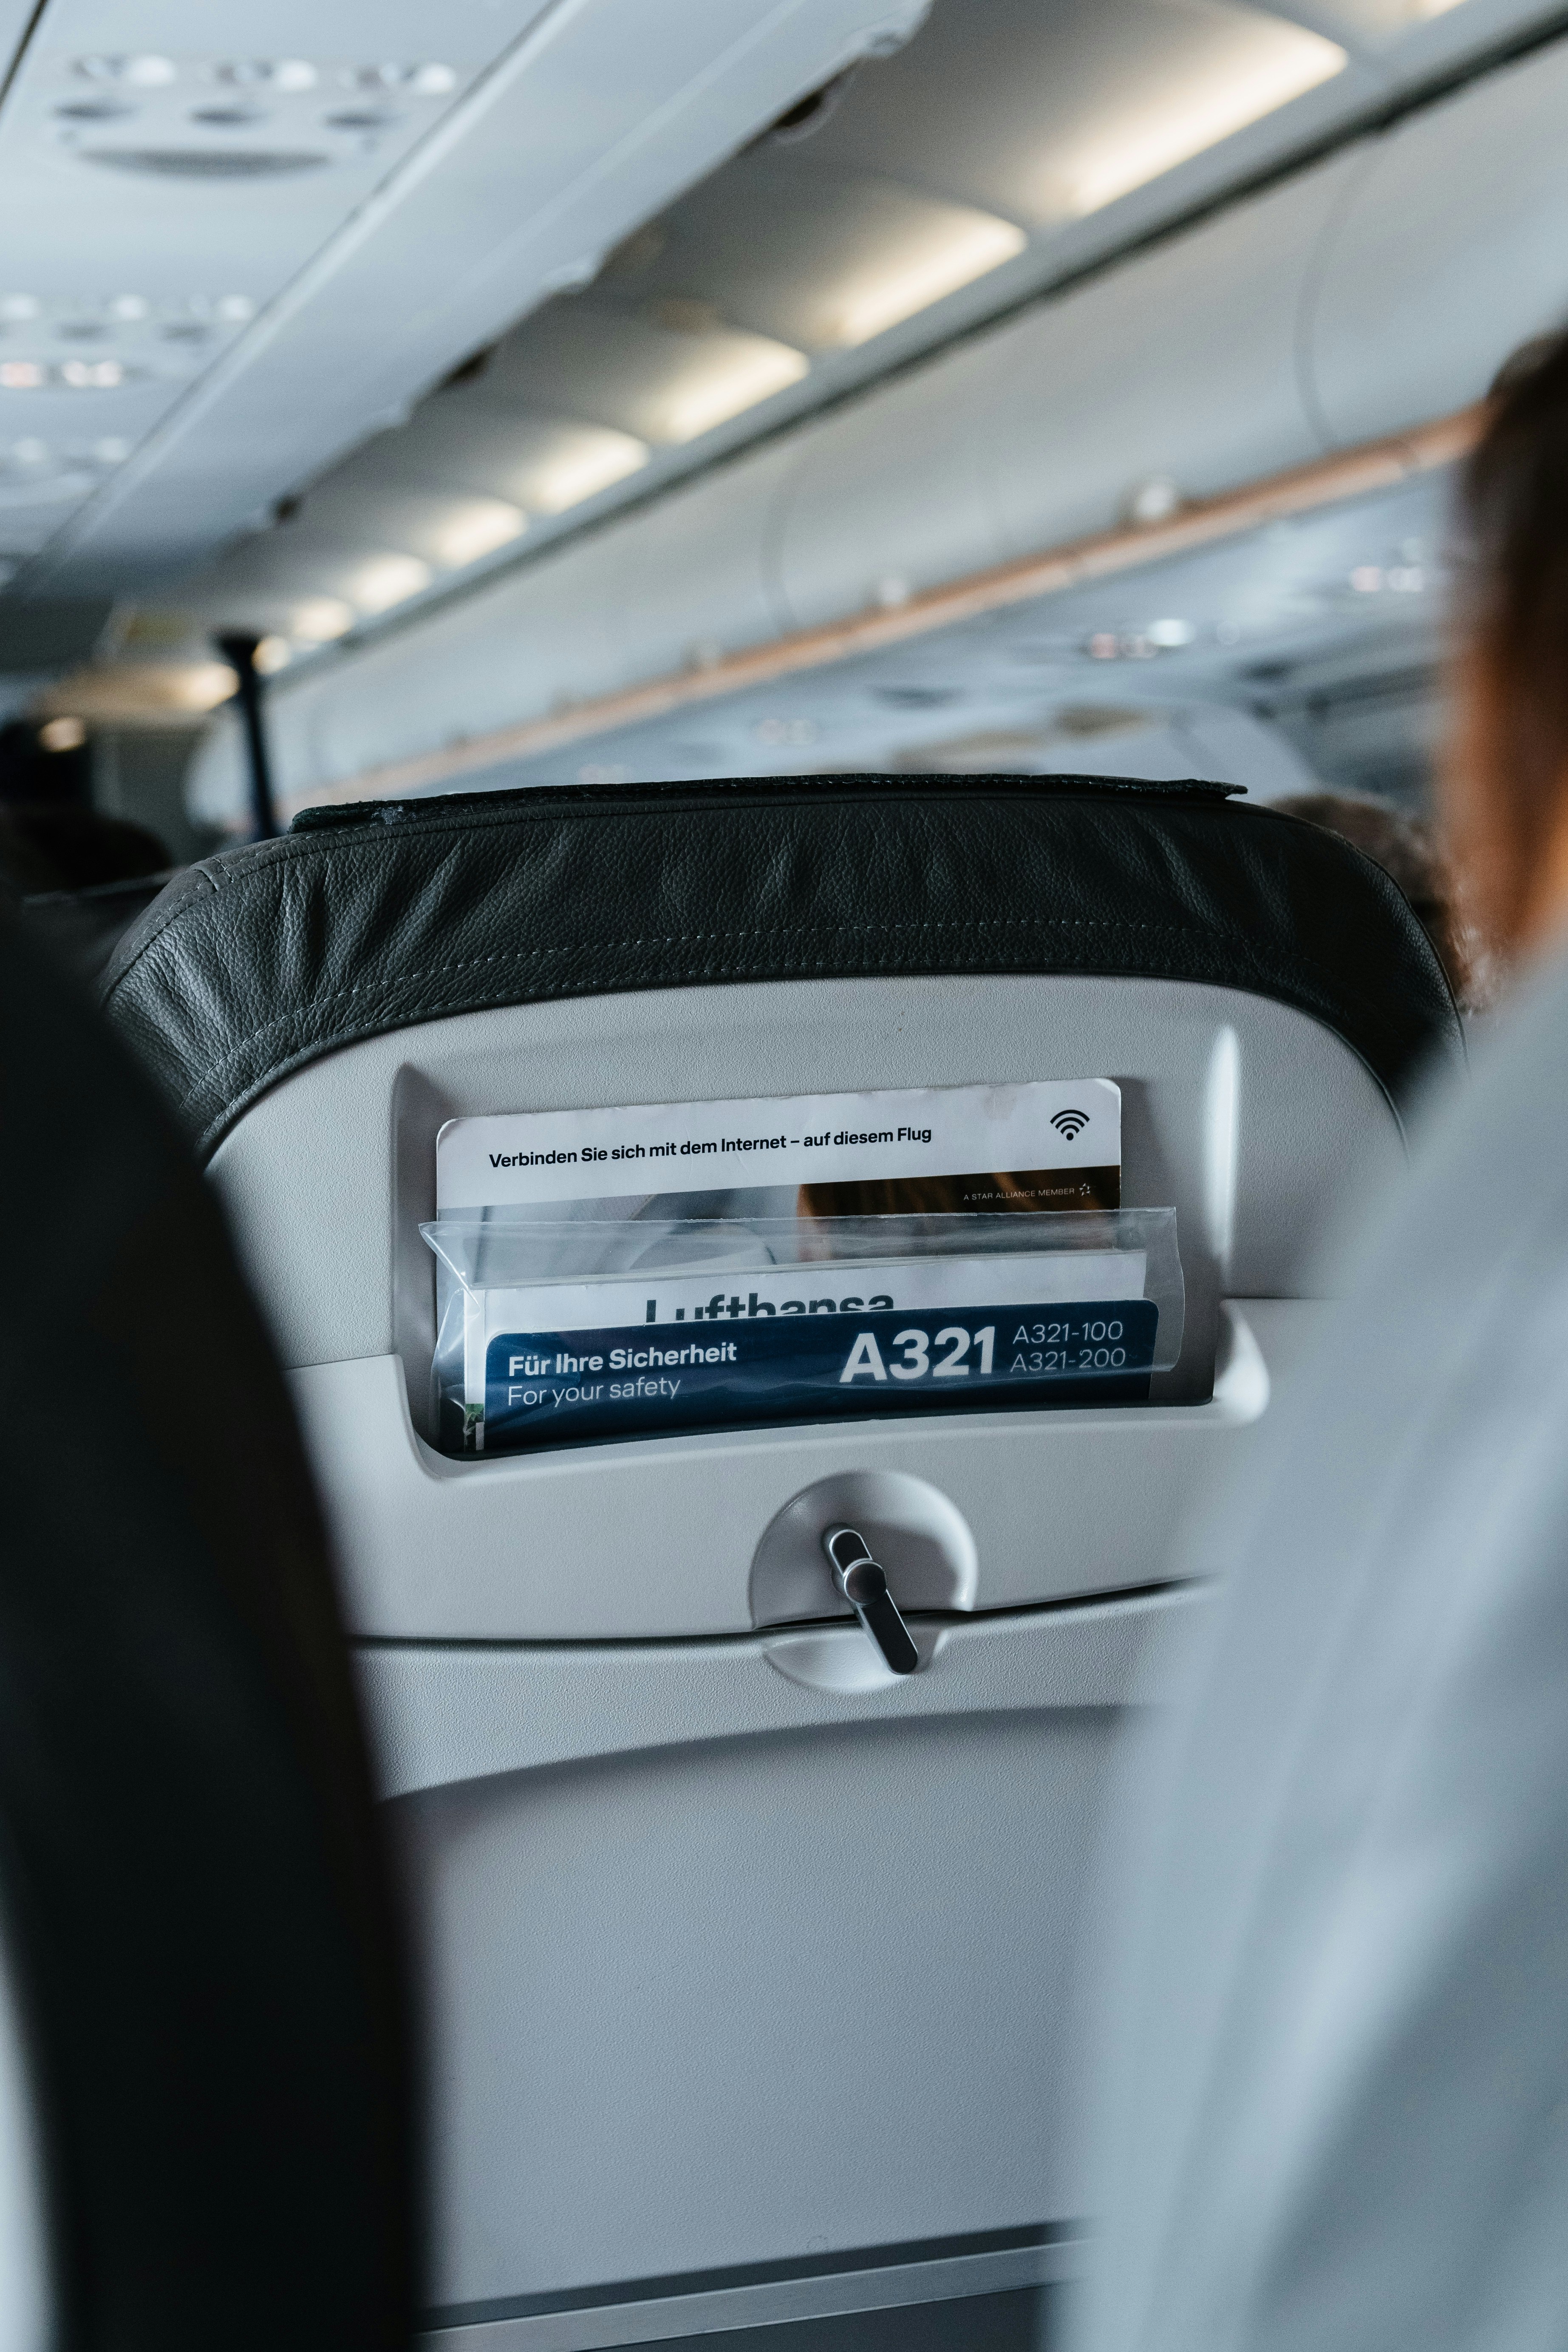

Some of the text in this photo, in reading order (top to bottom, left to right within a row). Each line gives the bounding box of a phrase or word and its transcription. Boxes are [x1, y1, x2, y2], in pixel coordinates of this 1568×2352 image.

[489, 1150, 577, 1168] Verbinden
[581, 1147, 608, 1162] Sie
[611, 1144, 645, 1160] sich
[649, 1142, 677, 1157] mit
[680, 1141, 717, 1155] dem
[722, 1135, 787, 1152] Internet
[804, 1132, 831, 1147] auf
[833, 1131, 893, 1145] diesem
[897, 1127, 931, 1143] Flug
[996, 1190, 1036, 1199] ALLIANCE
[1038, 1188, 1075, 1197] MEMBER
[1013, 1321, 1124, 1344] A321-100
[509, 1342, 737, 1376] Für Ihre Sicherheit
[839, 1326, 996, 1383] A321
[1010, 1347, 1126, 1373] A321-200
[508, 1376, 681, 1408] For your safety
